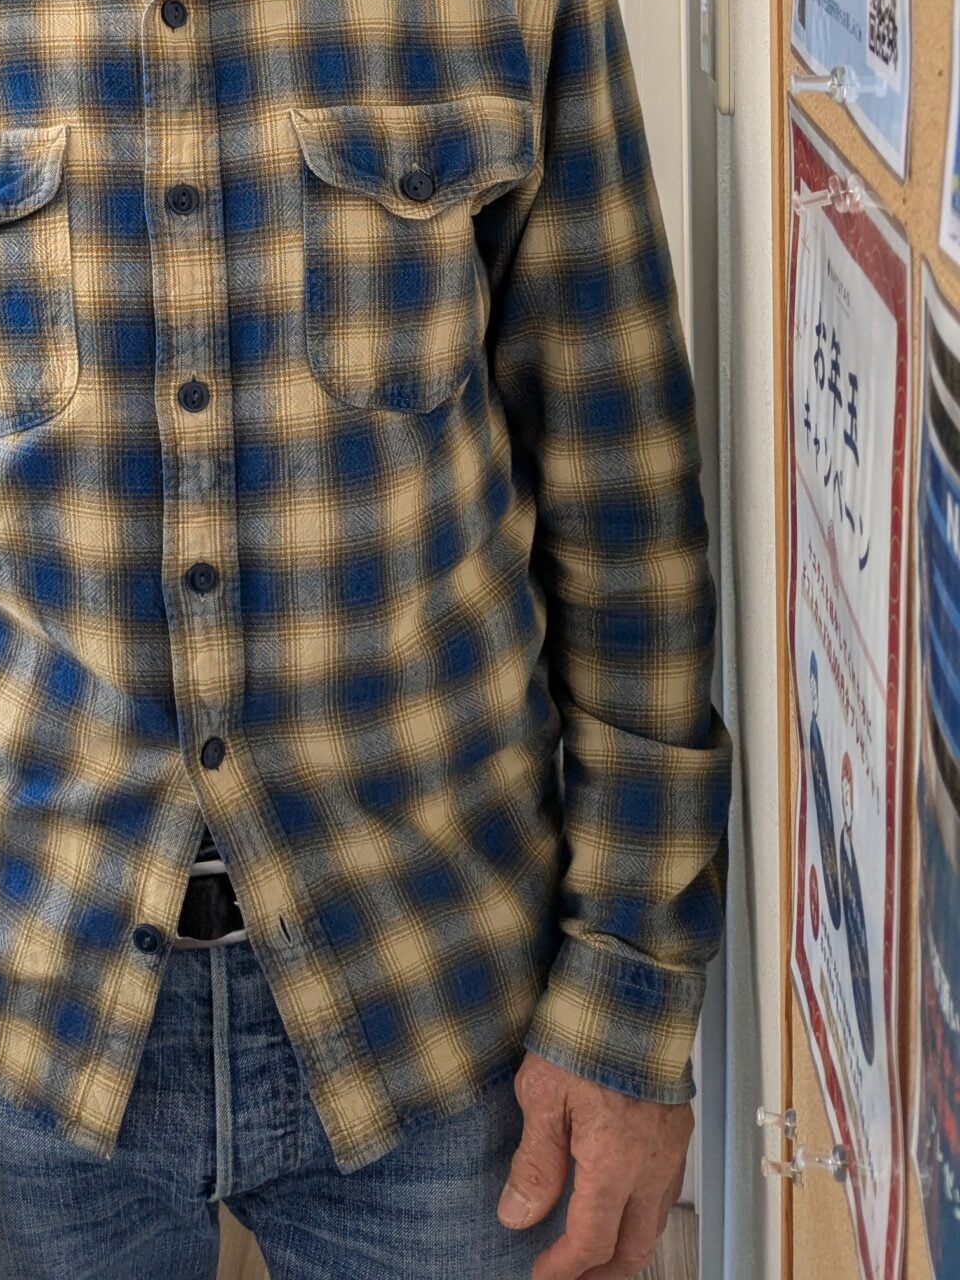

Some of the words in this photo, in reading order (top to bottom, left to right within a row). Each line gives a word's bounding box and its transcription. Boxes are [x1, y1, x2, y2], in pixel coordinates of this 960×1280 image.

[813, 301, 860, 468] お年玉
[803, 389, 872, 572] キャンペーン
